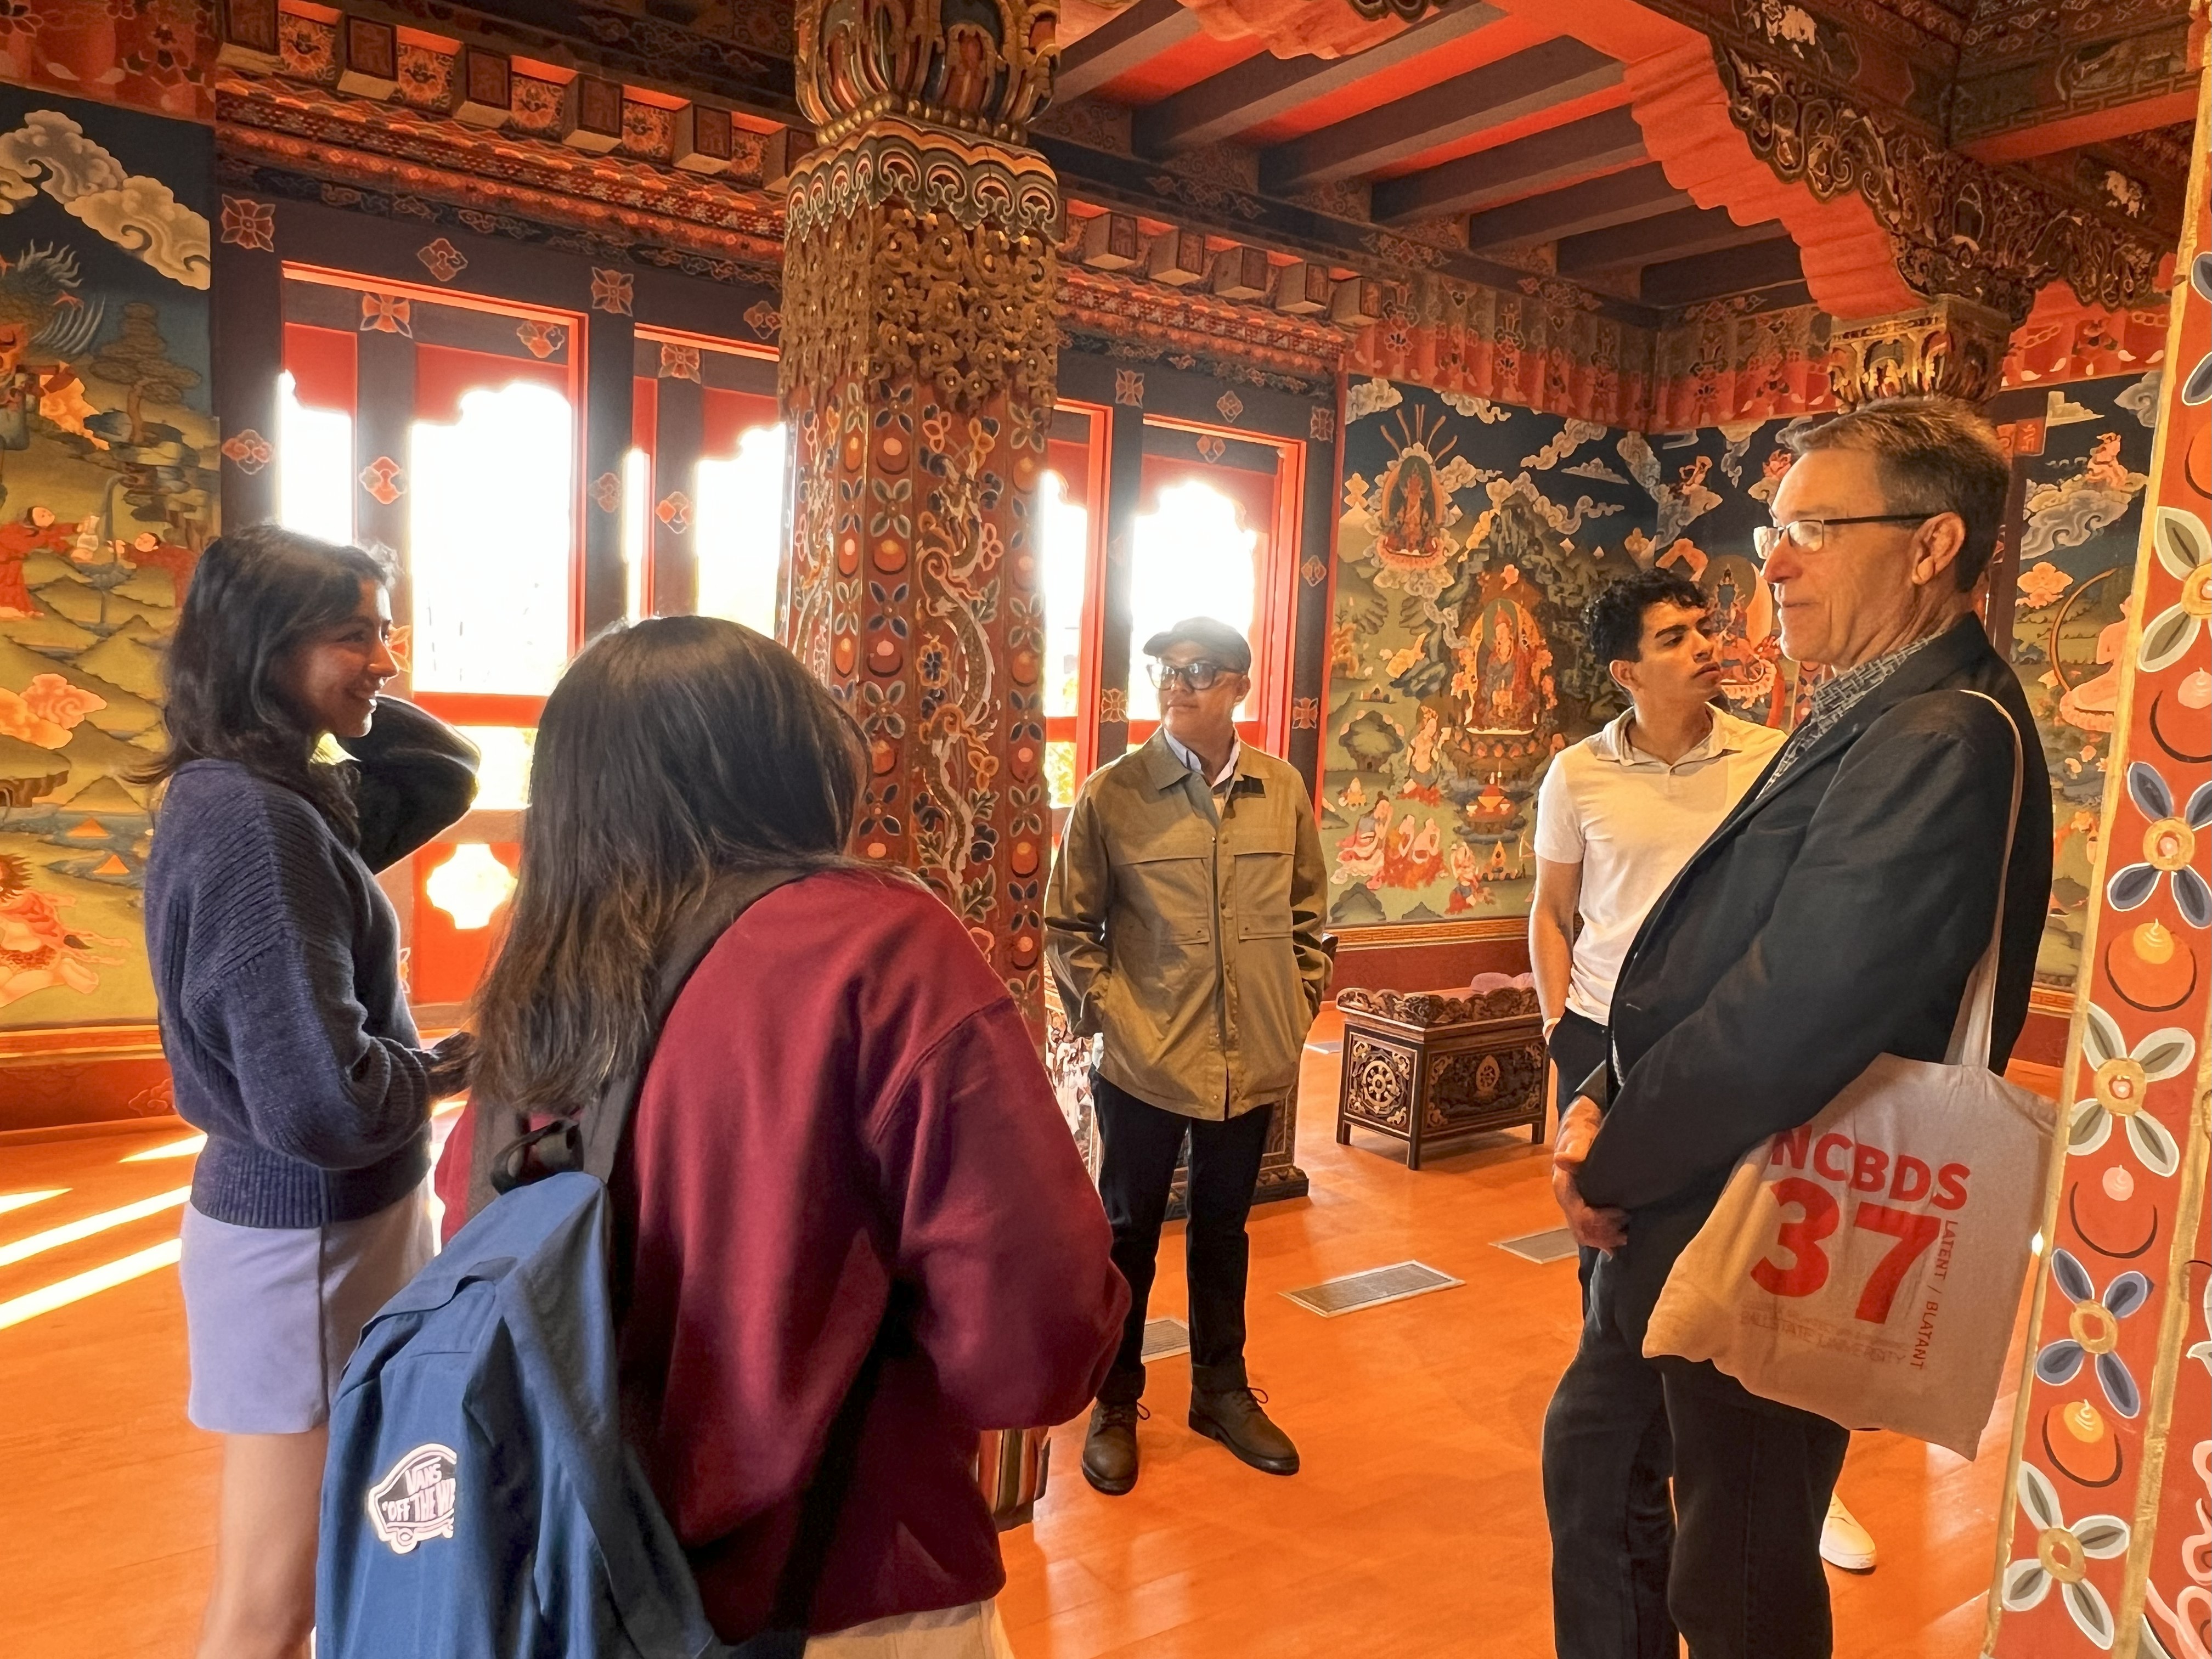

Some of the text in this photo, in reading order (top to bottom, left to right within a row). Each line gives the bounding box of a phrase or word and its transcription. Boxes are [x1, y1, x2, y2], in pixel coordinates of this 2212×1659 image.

[1770, 1125, 1970, 1210] NCBDS
[1750, 1177, 1941, 1324] 37
[1934, 1220, 1958, 1280] LATENT
[1910, 1300, 1938, 1370] BLATANT
[405, 1457, 442, 1496] VANS
[410, 1486, 436, 1522] THE
